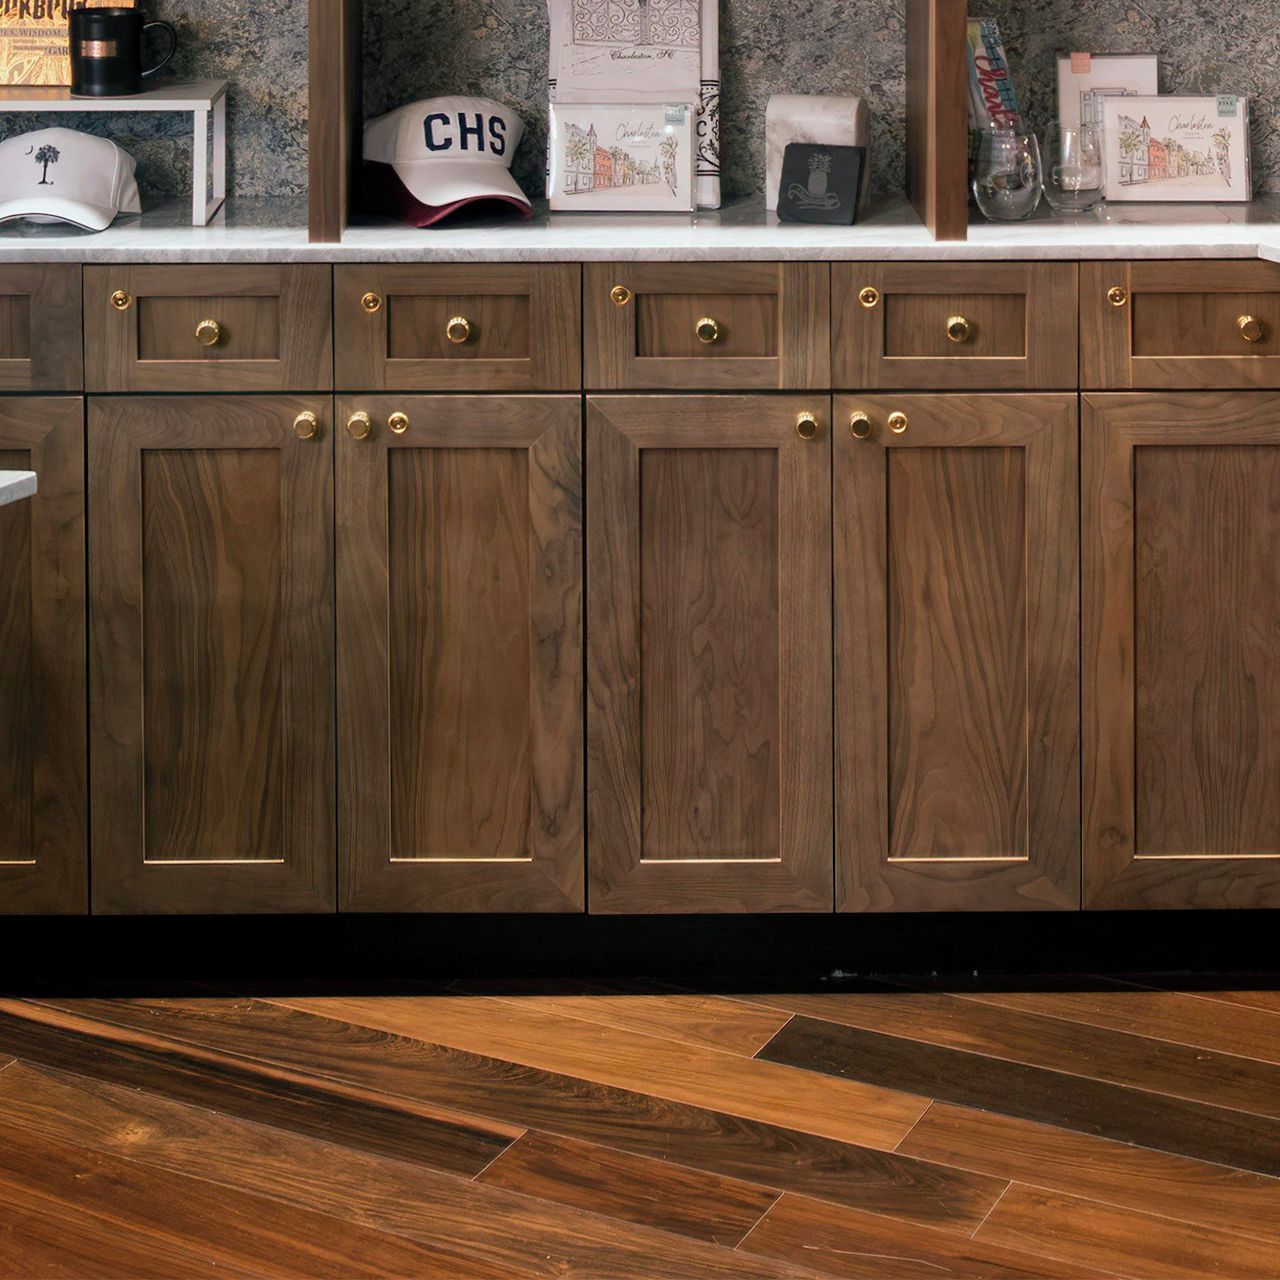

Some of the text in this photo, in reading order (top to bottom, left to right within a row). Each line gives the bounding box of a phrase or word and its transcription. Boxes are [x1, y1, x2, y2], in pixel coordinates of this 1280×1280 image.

[19, 28, 65, 38] WISDOM,
[615, 121, 664, 141] Charleston
[1168, 112, 1214, 132] Charleston
[423, 112, 507, 156] CHS
